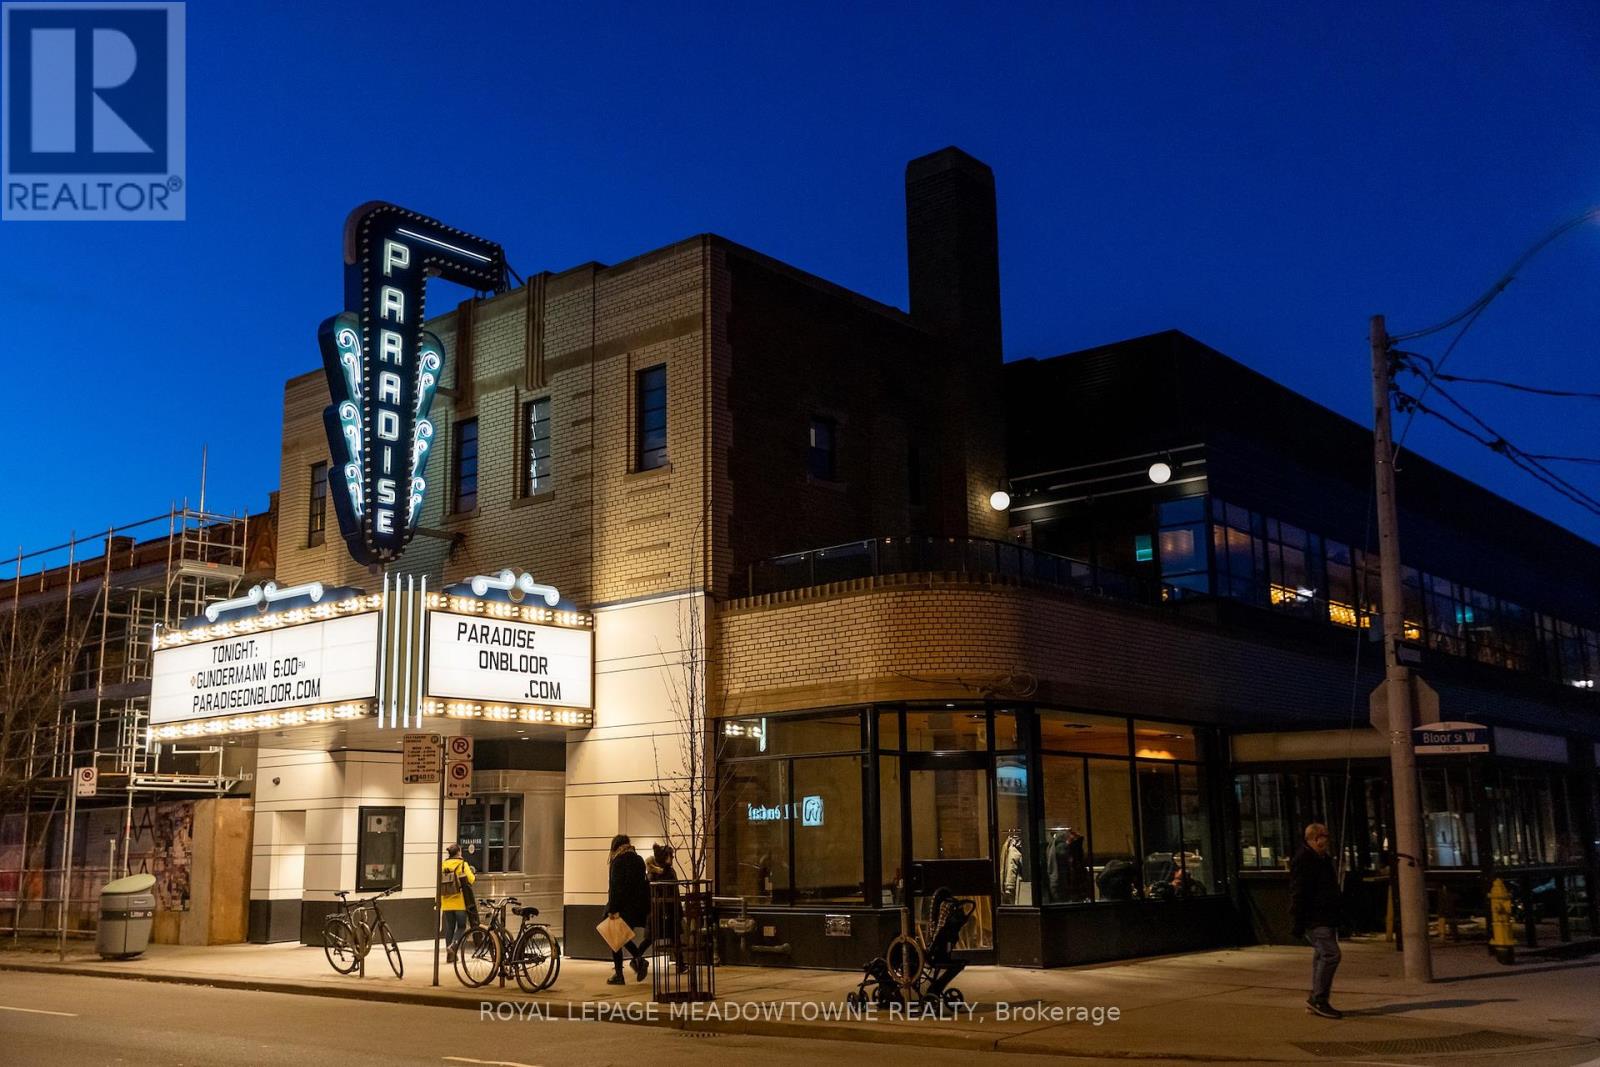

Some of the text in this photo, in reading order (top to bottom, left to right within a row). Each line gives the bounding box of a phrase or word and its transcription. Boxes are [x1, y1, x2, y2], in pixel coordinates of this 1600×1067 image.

[376, 237, 411, 533] PARADISE
[457, 622, 536, 649] PARADISE
[212, 640, 258, 664] TONIGHT:
[479, 650, 548, 675] ONBLOOR
[196, 662, 267, 690] GUNDERMANN
[192, 678, 320, 713] PARADISEONBLOOR.COM
[524, 680, 561, 700] .COM
[1423, 731, 1476, 744] Bloor St W
